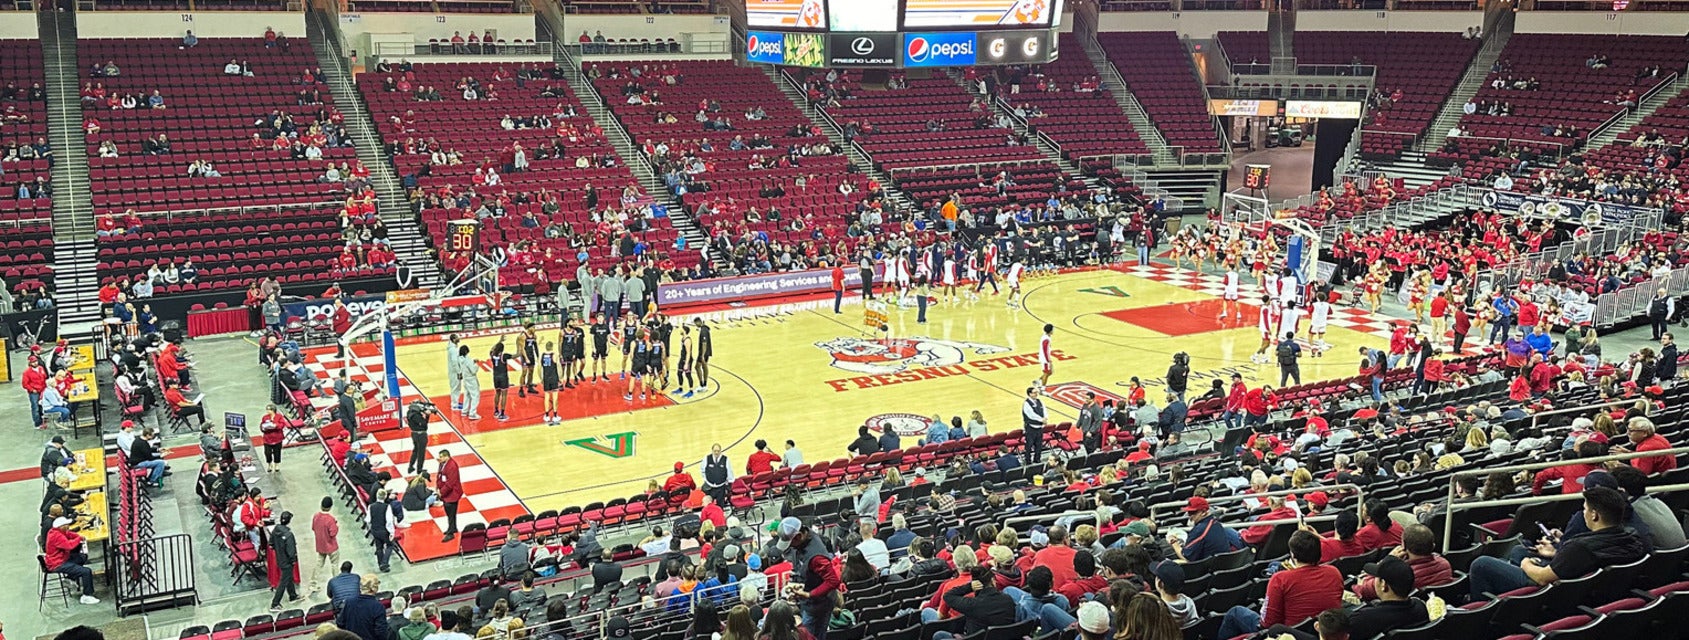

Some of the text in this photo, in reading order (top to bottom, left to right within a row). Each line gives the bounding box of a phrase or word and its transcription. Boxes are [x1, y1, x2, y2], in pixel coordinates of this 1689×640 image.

[181, 14, 193, 22] 124
[435, 15, 446, 23] 123
[645, 16, 655, 24] 122
[759, 40, 782, 56] pepsi
[930, 39, 974, 59] pepsi
[1247, 174, 1258, 187] 30
[453, 233, 472, 250] 30
[665, 288, 684, 299] 20+
[685, 286, 712, 298] Years
[712, 285, 723, 296] of
[723, 280, 779, 294] Engineering
[780, 275, 818, 287] Services
[824, 365, 969, 393] FRESNO
[364, 419, 387, 427] CENTER
